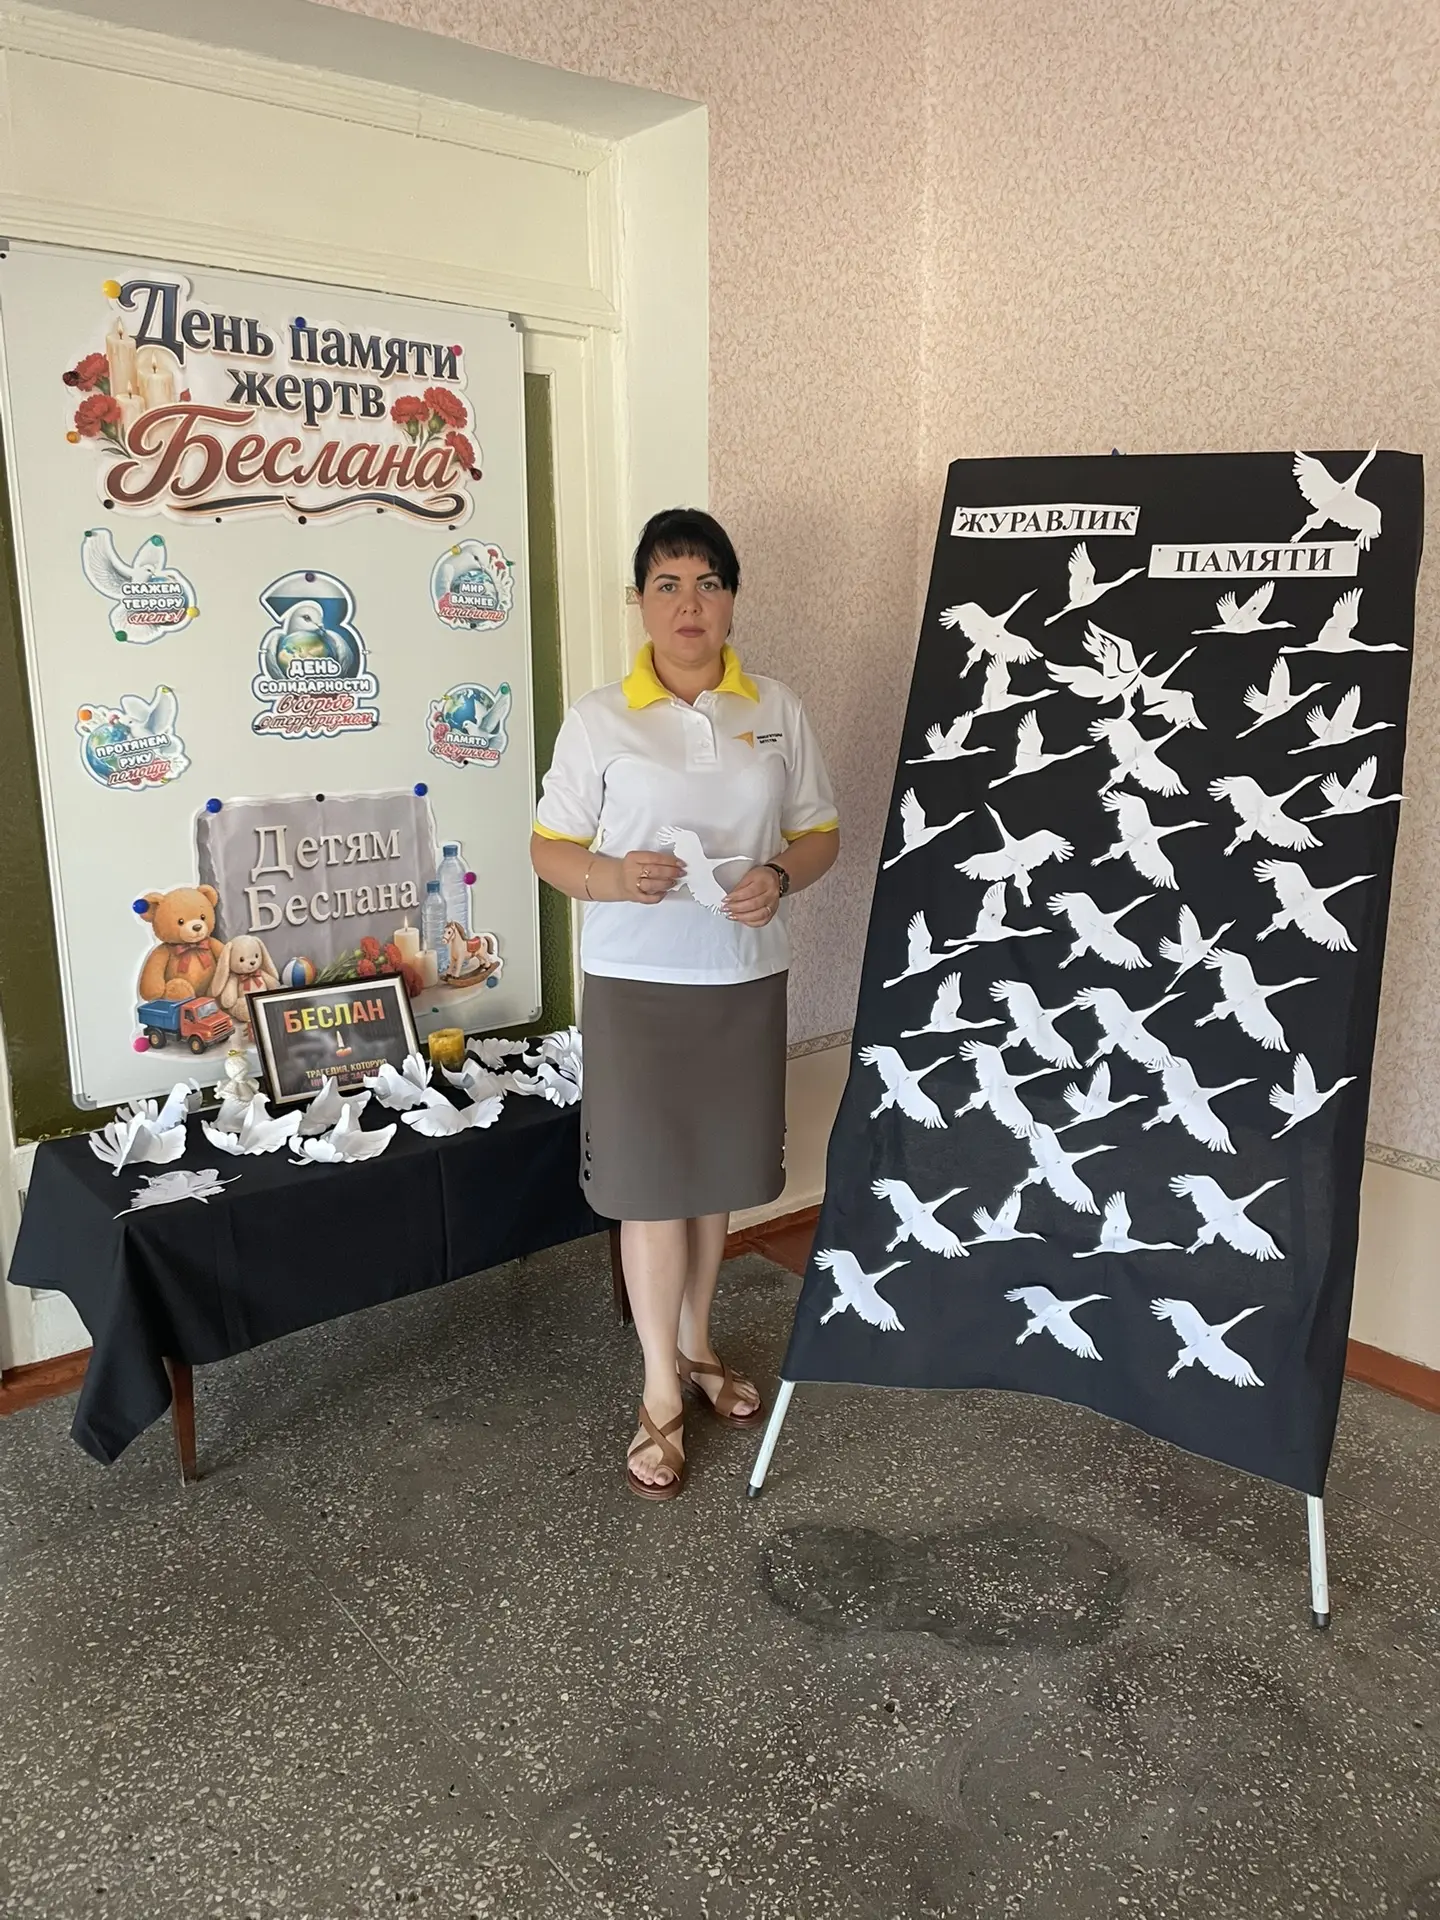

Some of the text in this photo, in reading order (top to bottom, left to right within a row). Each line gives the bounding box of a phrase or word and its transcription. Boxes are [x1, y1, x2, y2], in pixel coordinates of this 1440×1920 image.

[118, 280, 461, 381] День памяти
[226, 368, 386, 427] жертв
[106, 404, 458, 500] Беслана
[957, 509, 1136, 534] ЖУРАВЛИК
[1174, 547, 1335, 573] ПАМЯТИ
[122, 583, 181, 595] СКАЖЕМ
[461, 583, 485, 593] МИР
[123, 598, 183, 609] ТЕРРОРУ
[451, 595, 494, 607] ВАЖНЕЕ
[289, 659, 340, 677] ДЕНЬ
[259, 679, 370, 693] СОЛИДАРНОСТИ
[277, 693, 354, 717] в борьбе
[271, 713, 373, 733] терроризмом
[96, 734, 169, 758] ПРОТЯНЕМ
[446, 734, 487, 746] ПАМЯТЬ
[119, 752, 152, 768] РУКУ
[108, 761, 171, 785] помощи
[250, 824, 401, 883] Детям
[244, 879, 420, 933] Беслана
[283, 998, 386, 1034] БЕСЛАН
